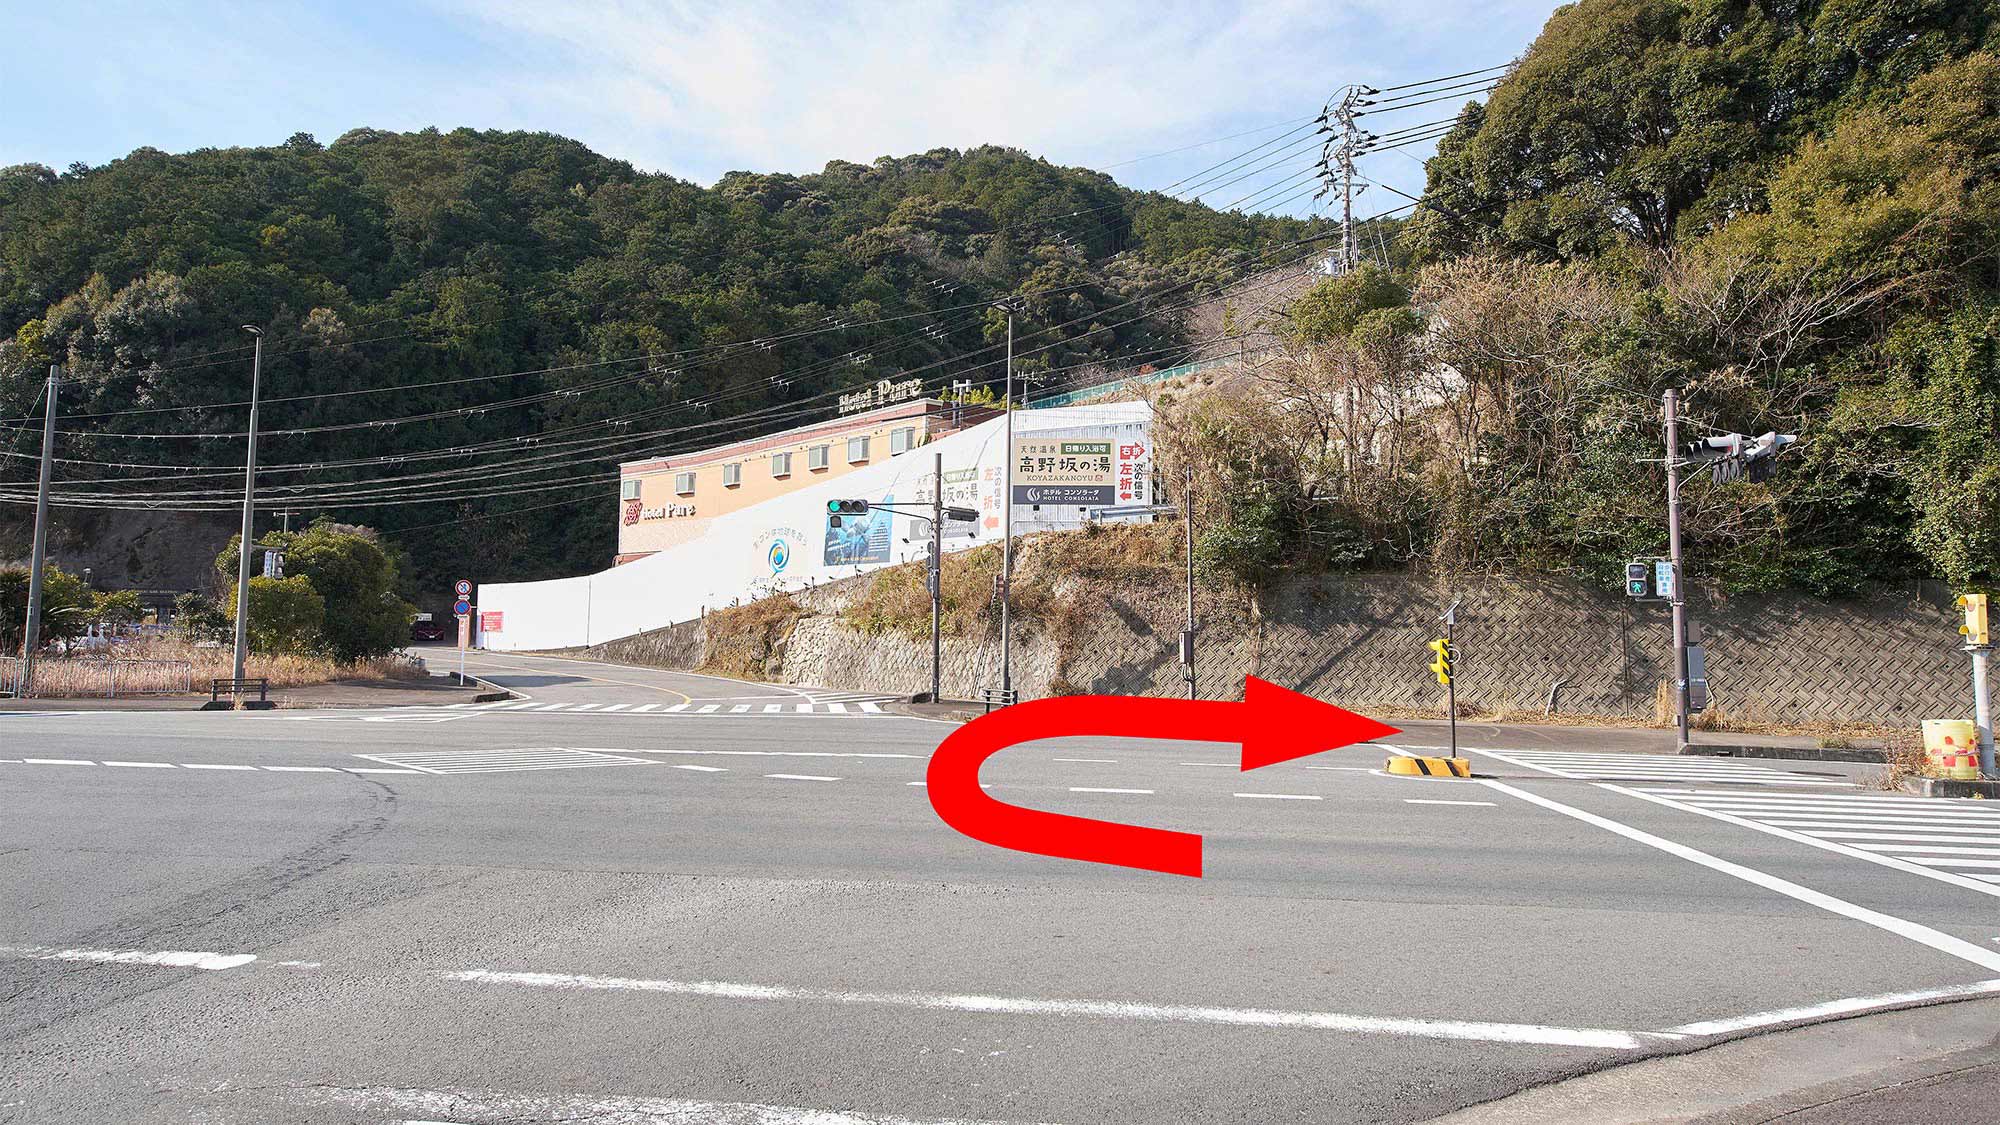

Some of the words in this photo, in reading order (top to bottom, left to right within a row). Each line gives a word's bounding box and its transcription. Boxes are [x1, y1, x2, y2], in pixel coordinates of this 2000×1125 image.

[838, 388, 872, 414] Hotel
[876, 379, 923, 405] Pure
[1020, 445, 1056, 454] 天然温泉
[1121, 446, 1140, 455] 右折
[1020, 456, 1110, 473] 高野坂の湯
[1120, 463, 1133, 490] 左折
[1134, 463, 1144, 499] 次の信号
[984, 468, 993, 510] 左折
[641, 507, 665, 520] Hotel
[667, 503, 696, 518] Pure
